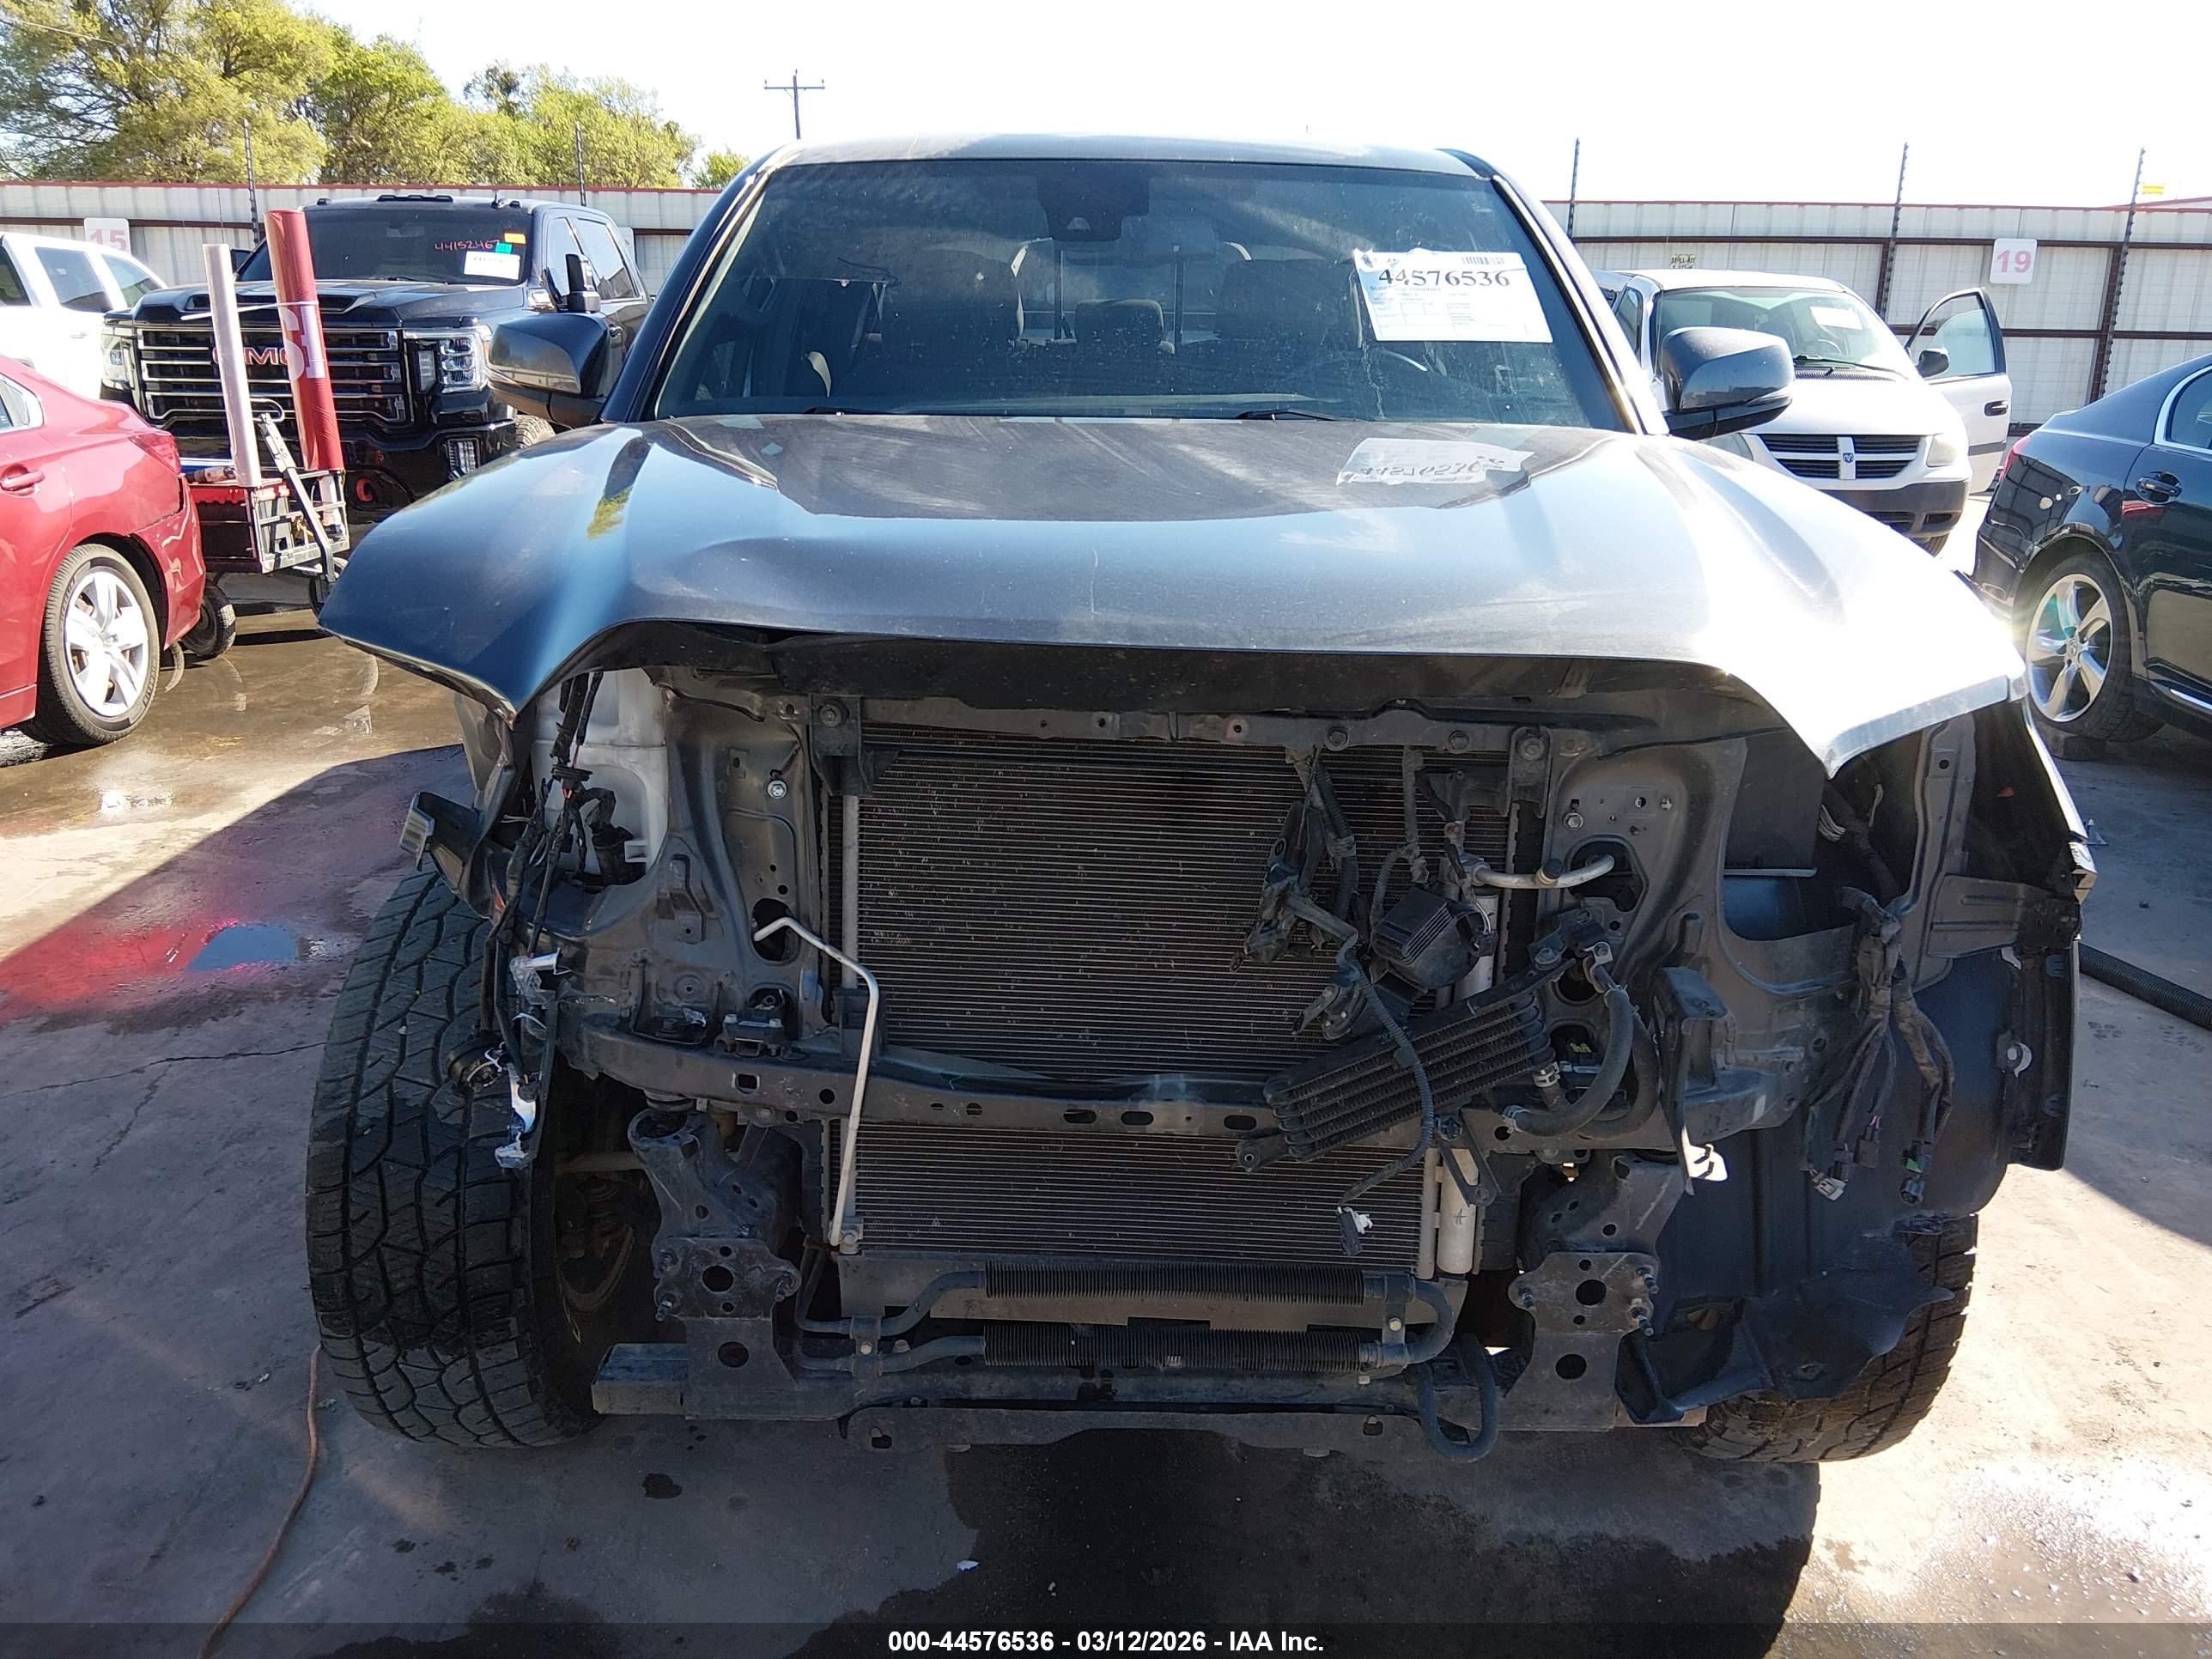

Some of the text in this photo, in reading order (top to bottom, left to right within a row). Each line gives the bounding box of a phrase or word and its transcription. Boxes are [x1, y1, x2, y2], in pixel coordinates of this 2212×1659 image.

[90, 229, 127, 251] 15
[1996, 250, 2032, 273] 19
[1378, 269, 1510, 287] 44576536
